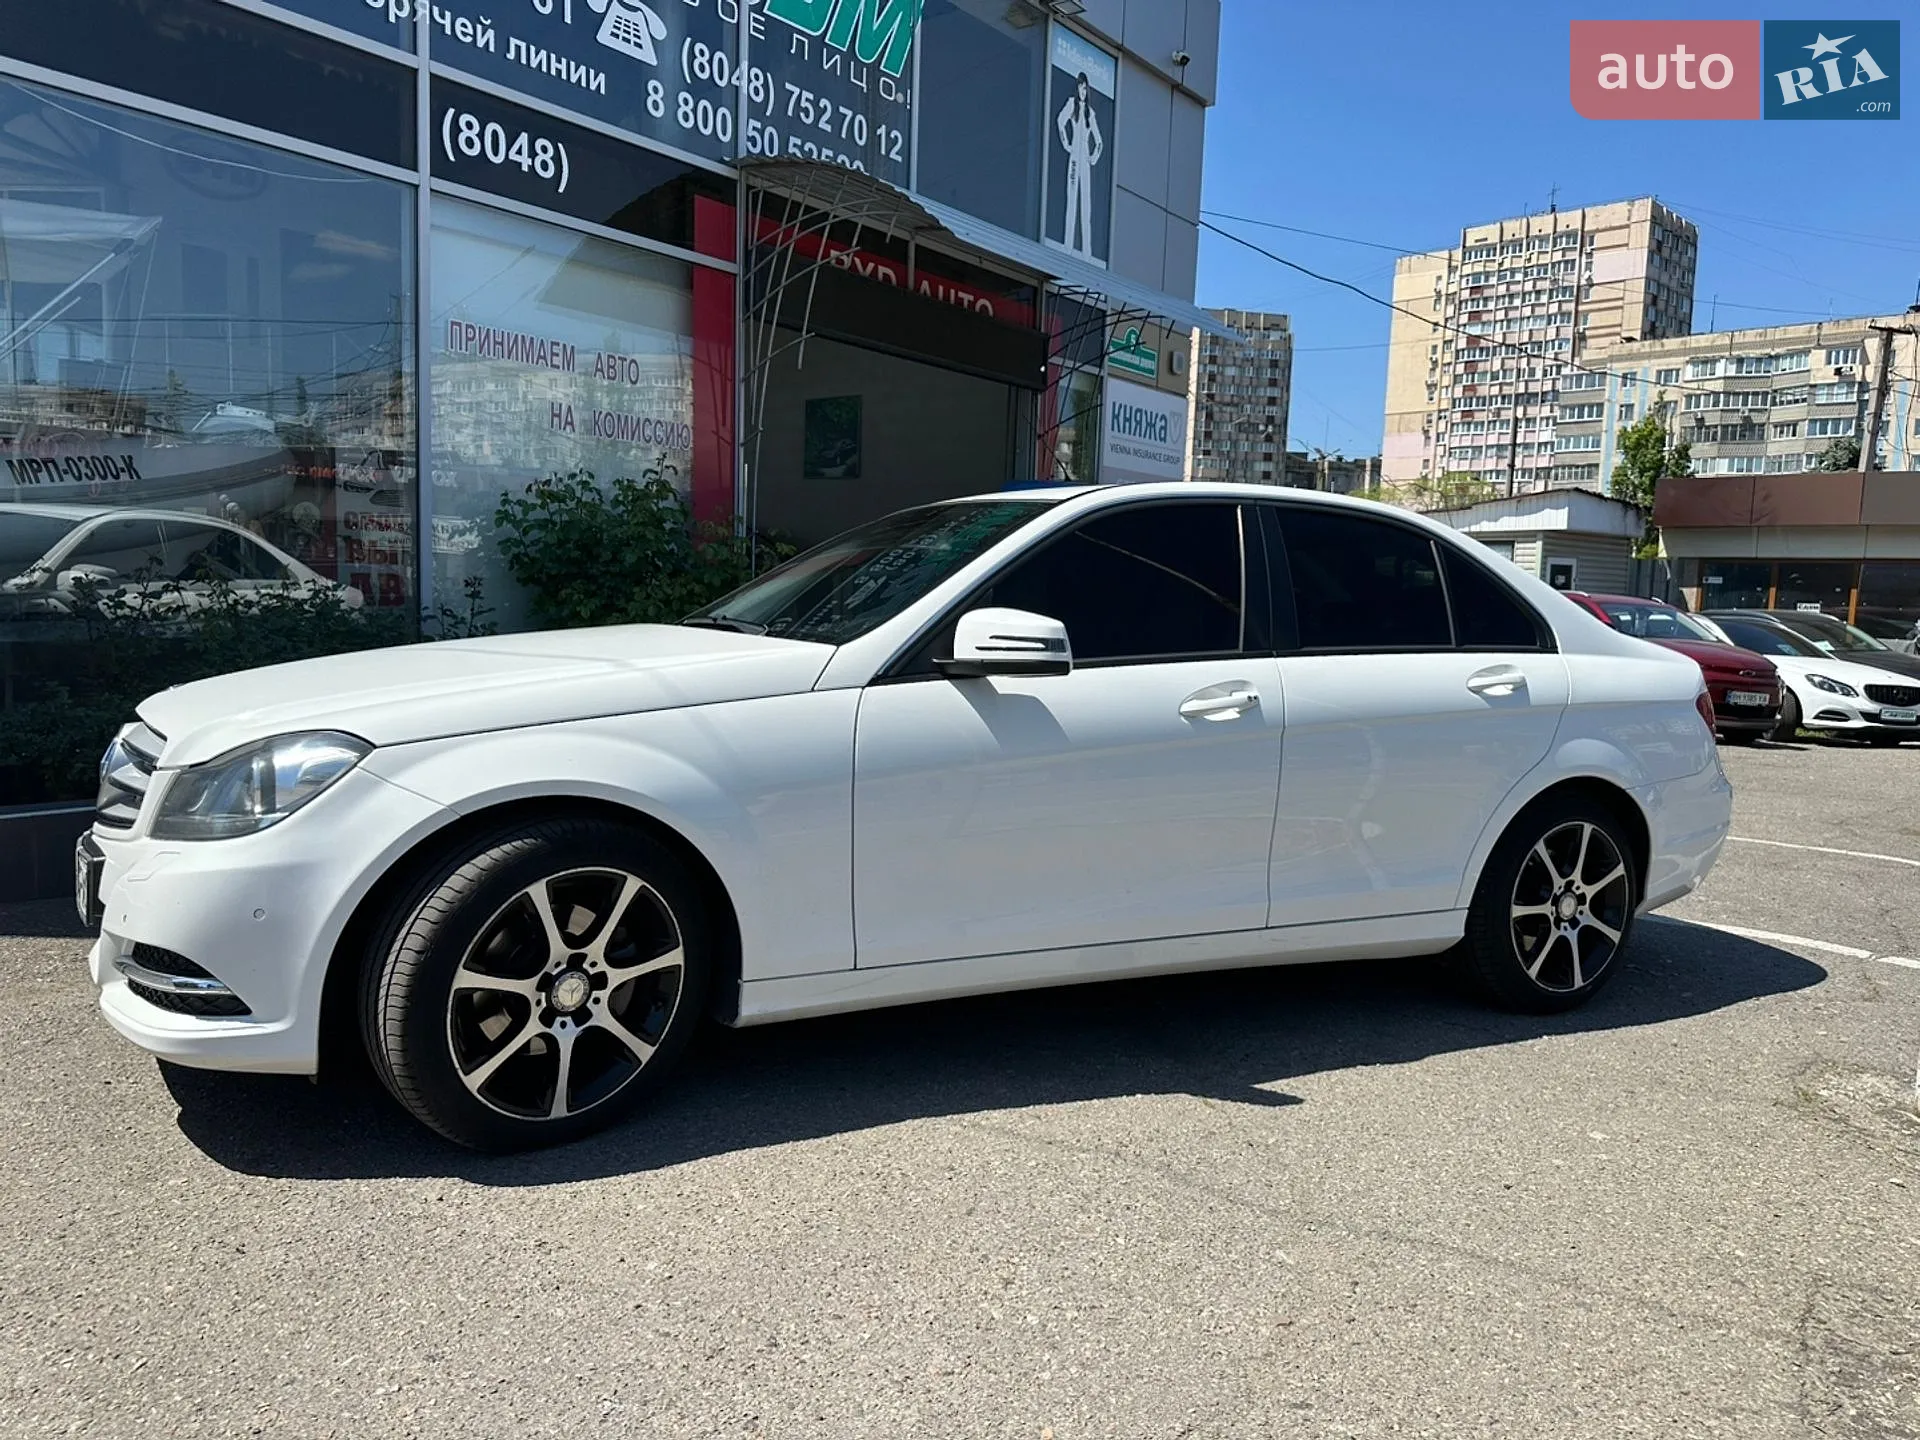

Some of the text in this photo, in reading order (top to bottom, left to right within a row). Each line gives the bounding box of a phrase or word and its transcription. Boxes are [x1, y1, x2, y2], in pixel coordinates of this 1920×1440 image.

[505, 36, 607, 95] линии
[646, 79, 666, 119] 8
[677, 91, 732, 143] 800
[746, 118, 779, 158] 50
[681, 37, 904, 163] (8048) 752 70 12
[442, 107, 569, 193] (8048)
[448, 318, 641, 386] ПРИНИМАЕМ АВТО
[550, 402, 691, 450] НА КОМИССИЮ
[1110, 401, 1168, 445] княжа
[5, 453, 142, 486] МРП-0300-К
[1109, 442, 1181, 465] VIENNA INSURANCE GROUP
